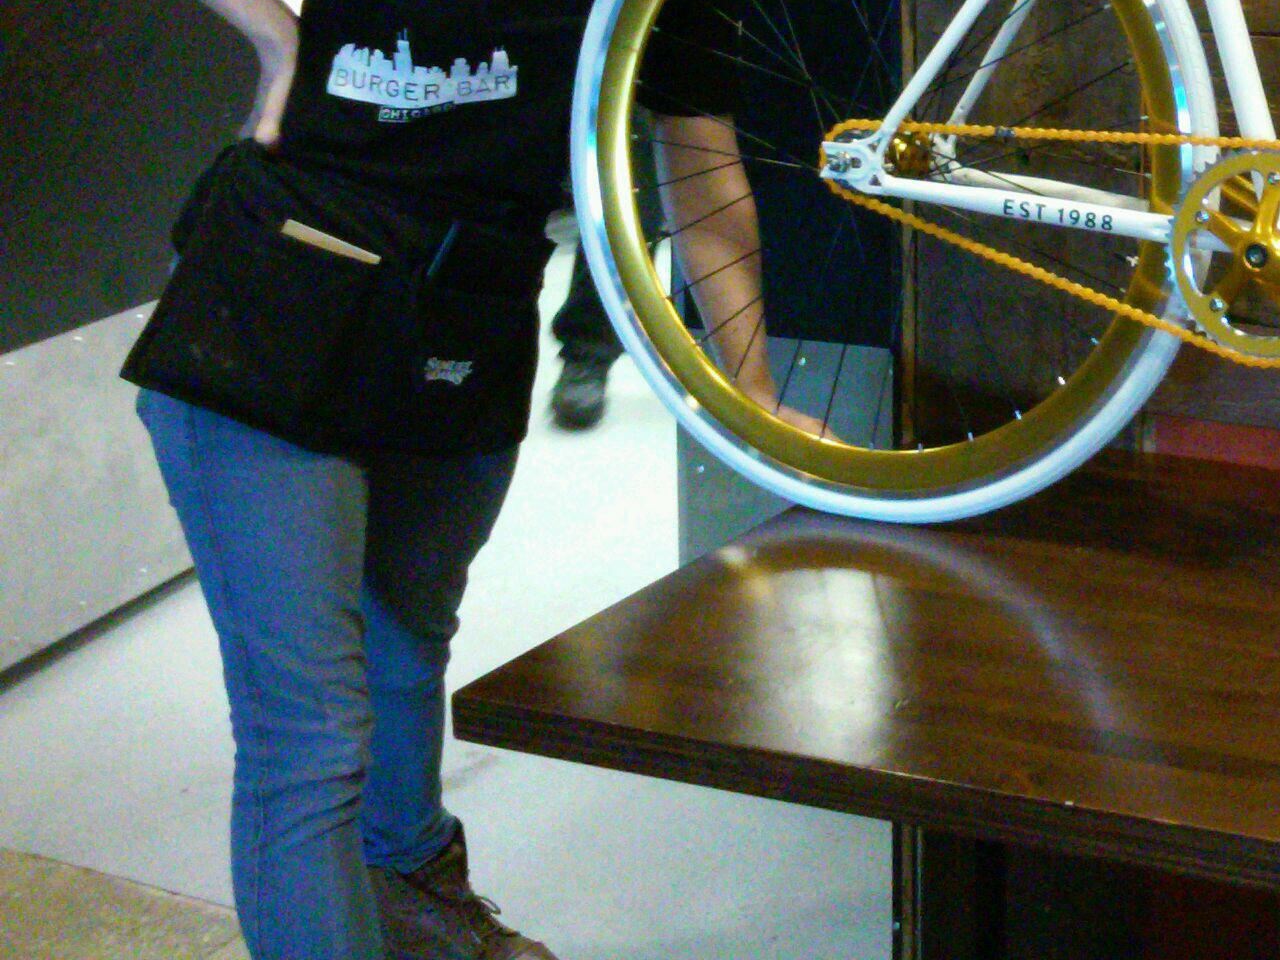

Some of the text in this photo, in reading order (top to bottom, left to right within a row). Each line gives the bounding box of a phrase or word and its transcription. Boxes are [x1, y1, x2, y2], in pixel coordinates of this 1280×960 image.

[335, 68, 510, 102] BURGER BAR
[1003, 198, 1113, 231] EST 1988
